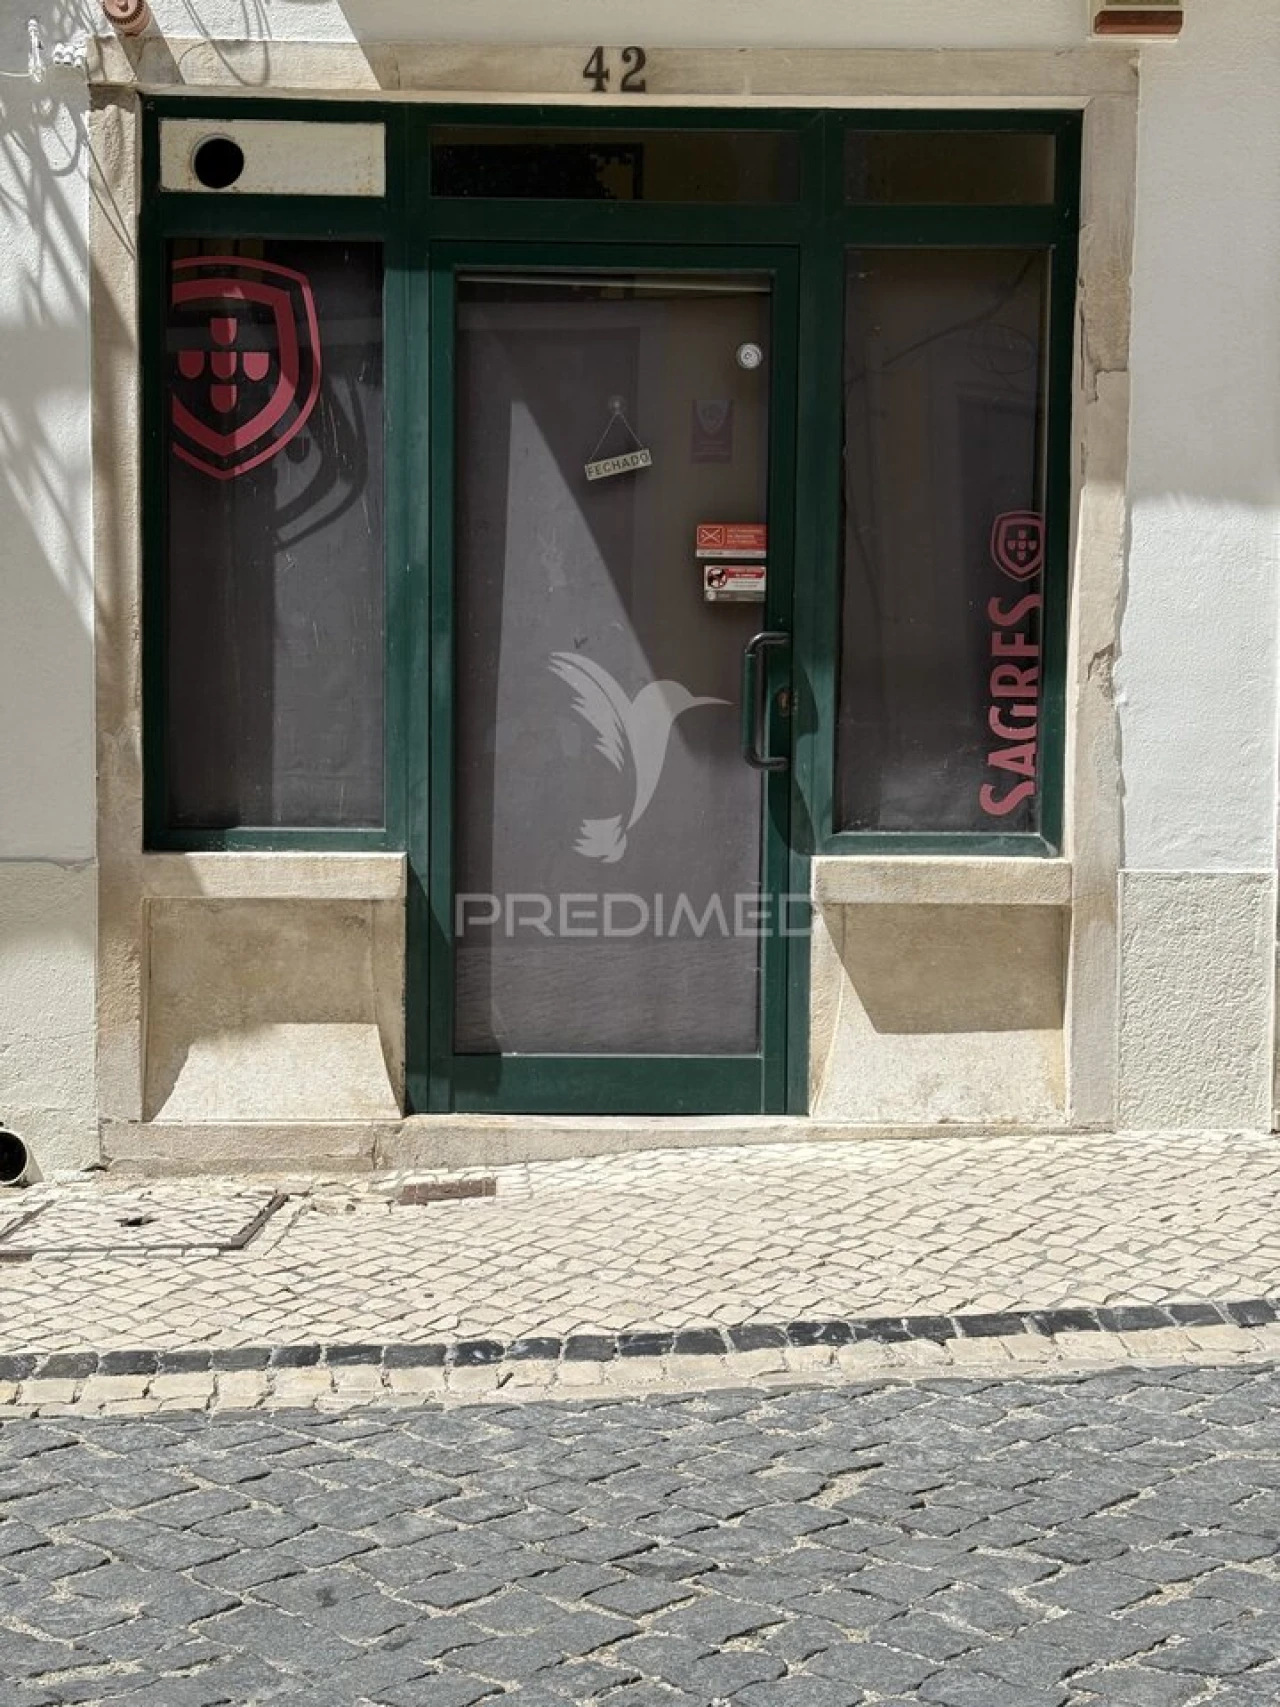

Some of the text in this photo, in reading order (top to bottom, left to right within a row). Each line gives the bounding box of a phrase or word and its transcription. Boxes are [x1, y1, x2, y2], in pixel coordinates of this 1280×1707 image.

[583, 46, 646, 92] 42
[587, 452, 649, 477] FECHADO
[979, 595, 1044, 817] SAGRES
